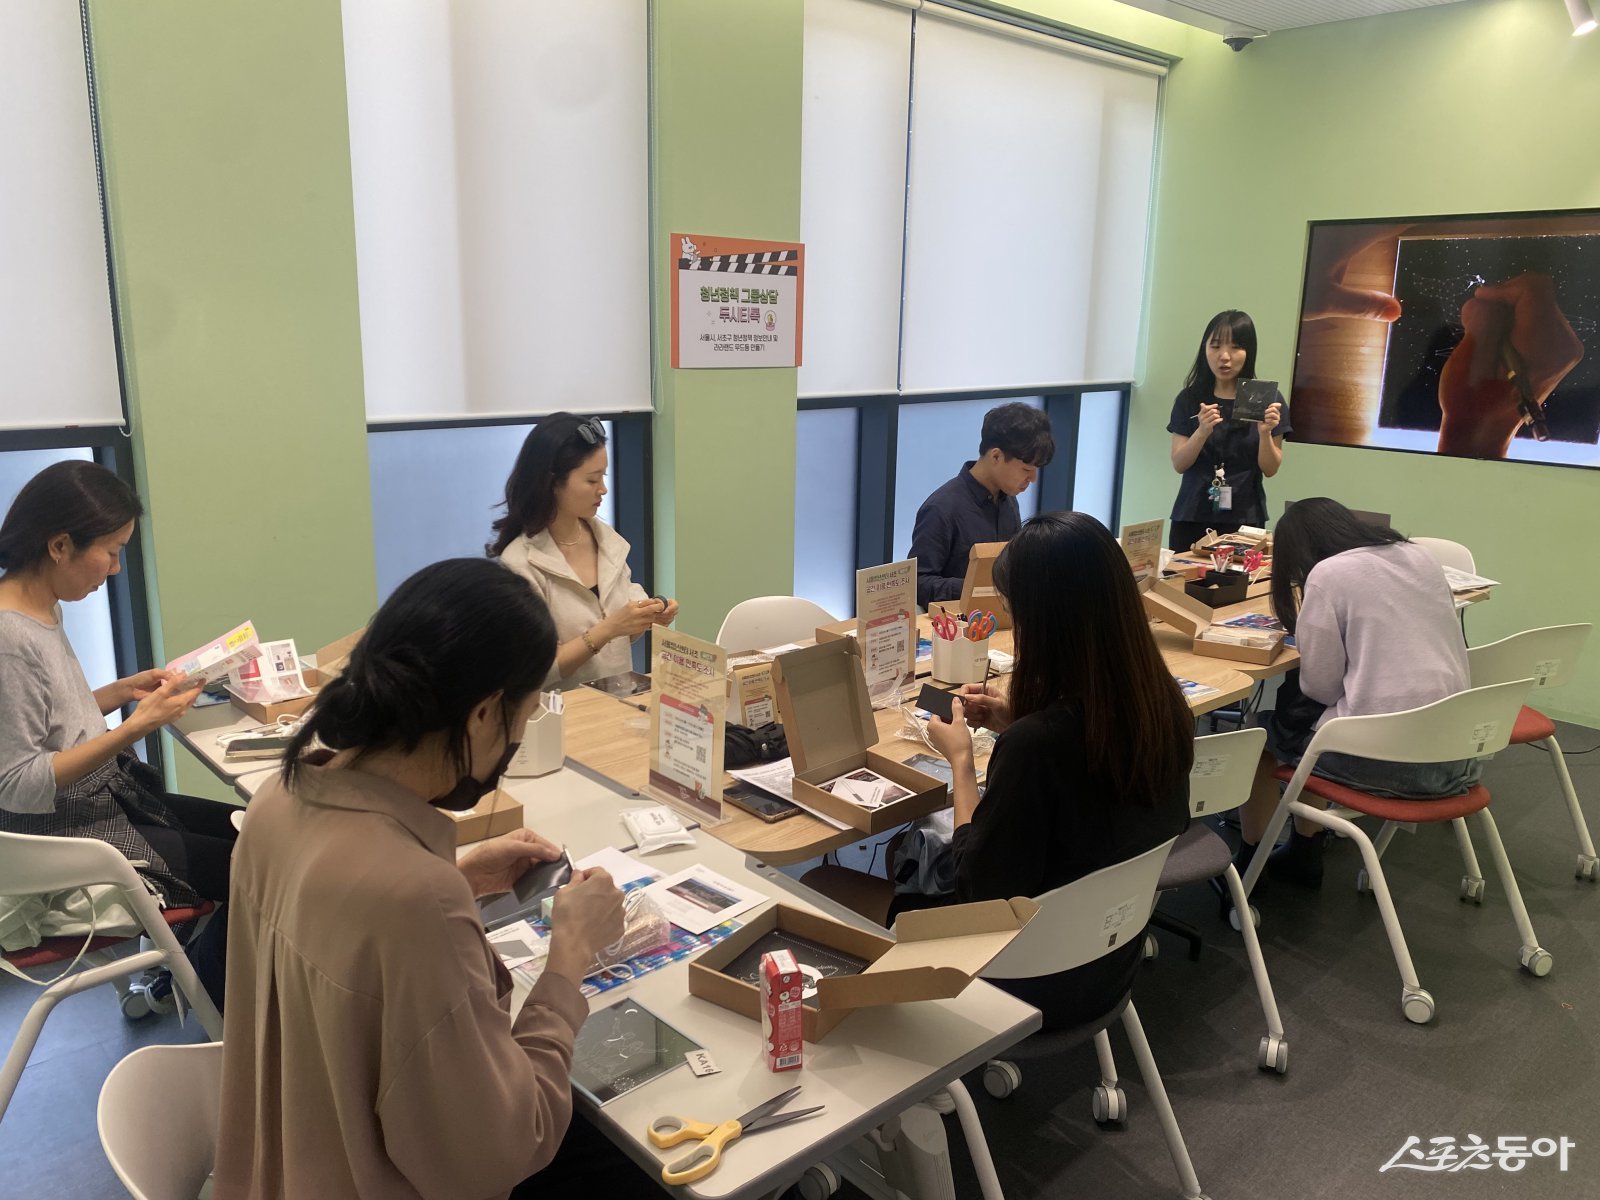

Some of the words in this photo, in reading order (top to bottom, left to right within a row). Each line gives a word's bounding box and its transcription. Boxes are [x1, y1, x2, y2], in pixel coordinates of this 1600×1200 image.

[700, 286, 739, 303] 청년정책
[741, 288, 778, 304] 그룹상담
[717, 334, 732, 342] 서초구
[733, 334, 752, 342] 청년정책
[753, 334, 772, 342] 정보안내
